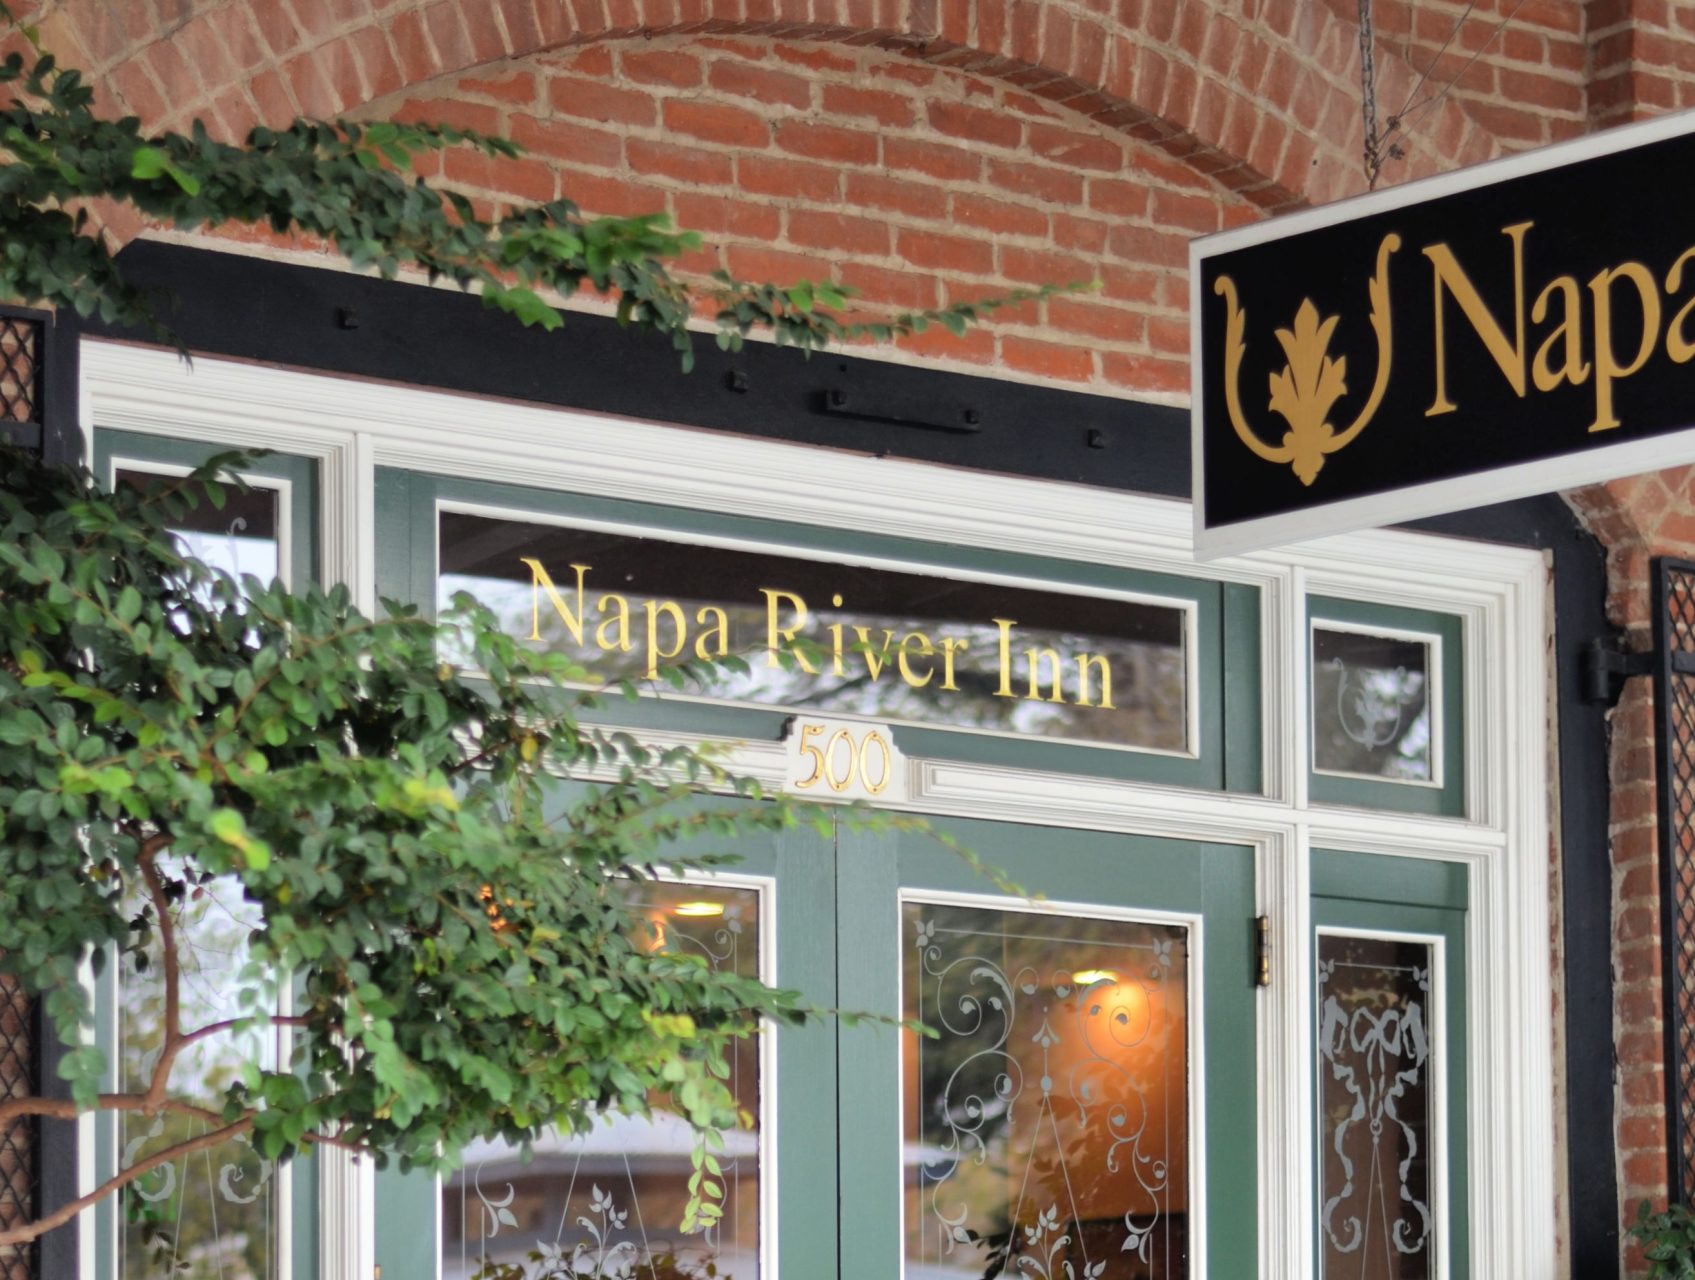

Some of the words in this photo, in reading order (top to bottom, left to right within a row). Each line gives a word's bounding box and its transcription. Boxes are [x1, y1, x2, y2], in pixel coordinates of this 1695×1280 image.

[520, 557, 728, 681] Napa
[759, 588, 968, 692] River
[991, 618, 1117, 709] Inn
[795, 724, 891, 795] 500
